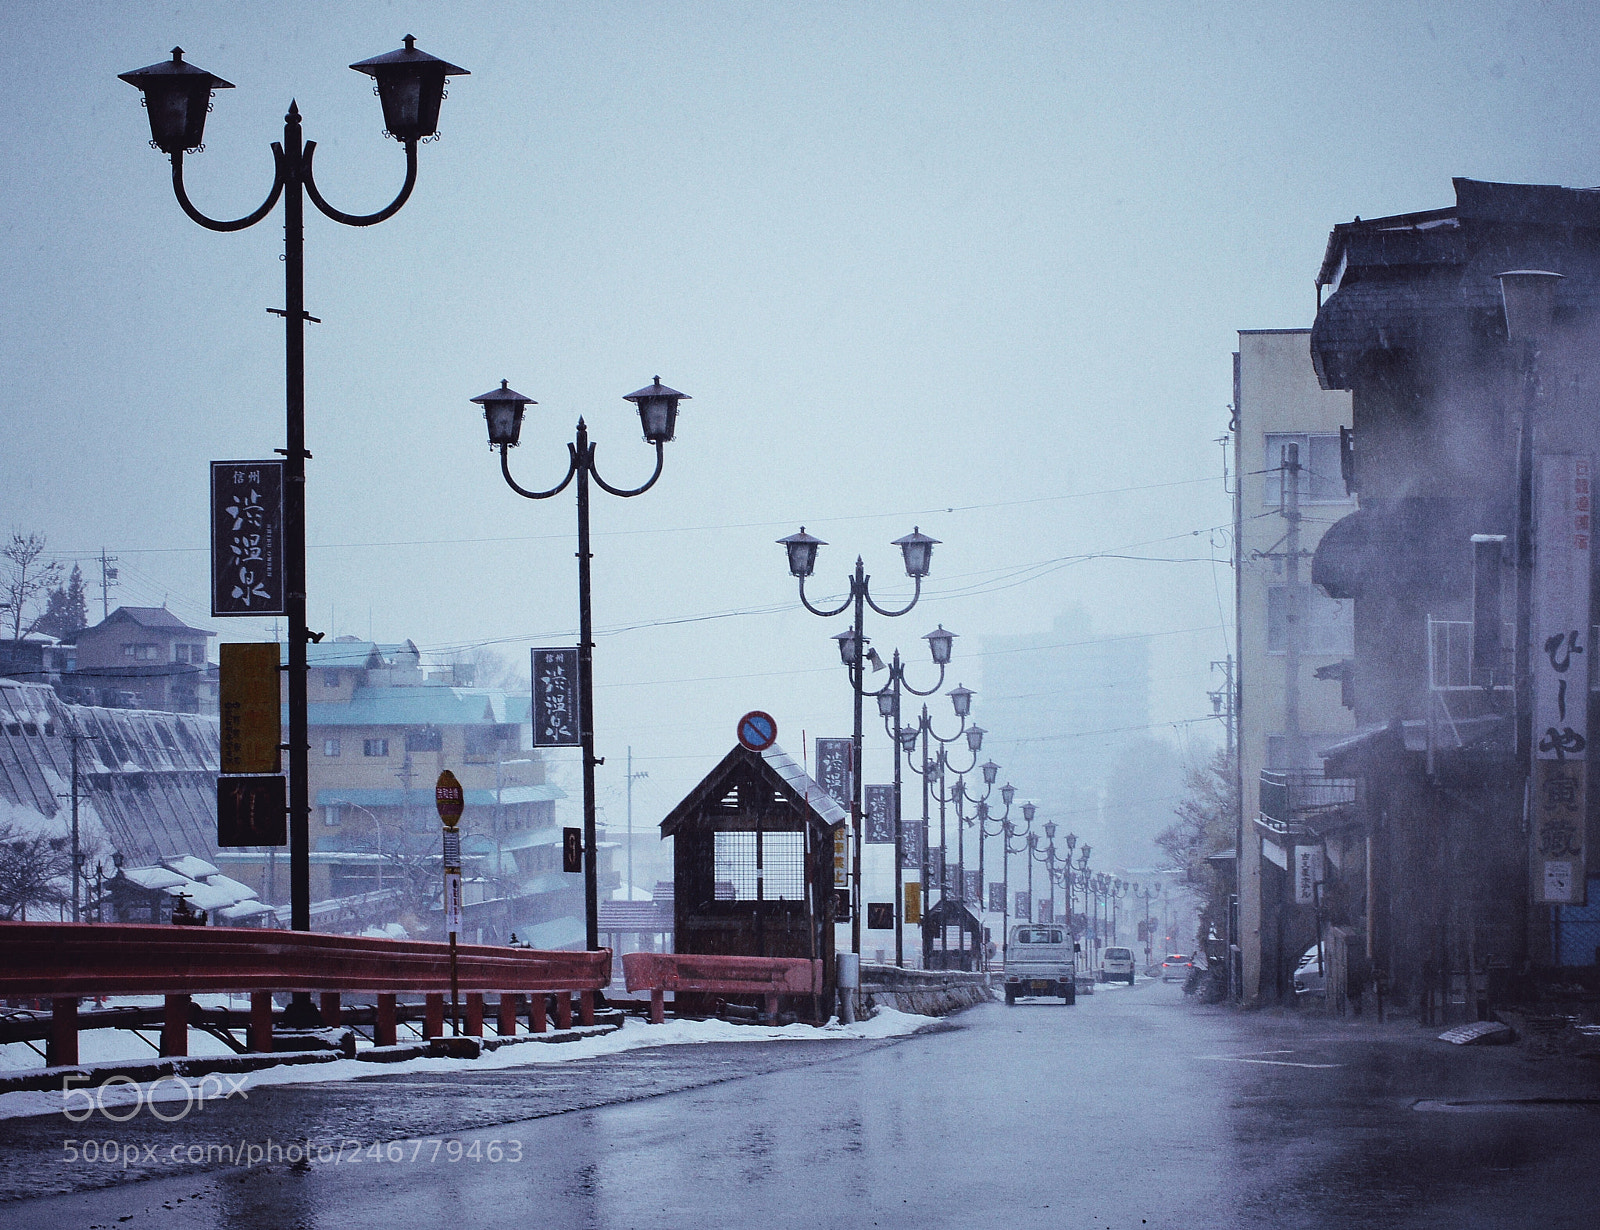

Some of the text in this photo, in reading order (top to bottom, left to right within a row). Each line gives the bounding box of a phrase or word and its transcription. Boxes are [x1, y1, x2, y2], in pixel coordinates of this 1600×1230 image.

[233, 470, 260, 484] 信州
[225, 488, 271, 606] 渋温泉
[540, 665, 571, 741] 渋温泉
